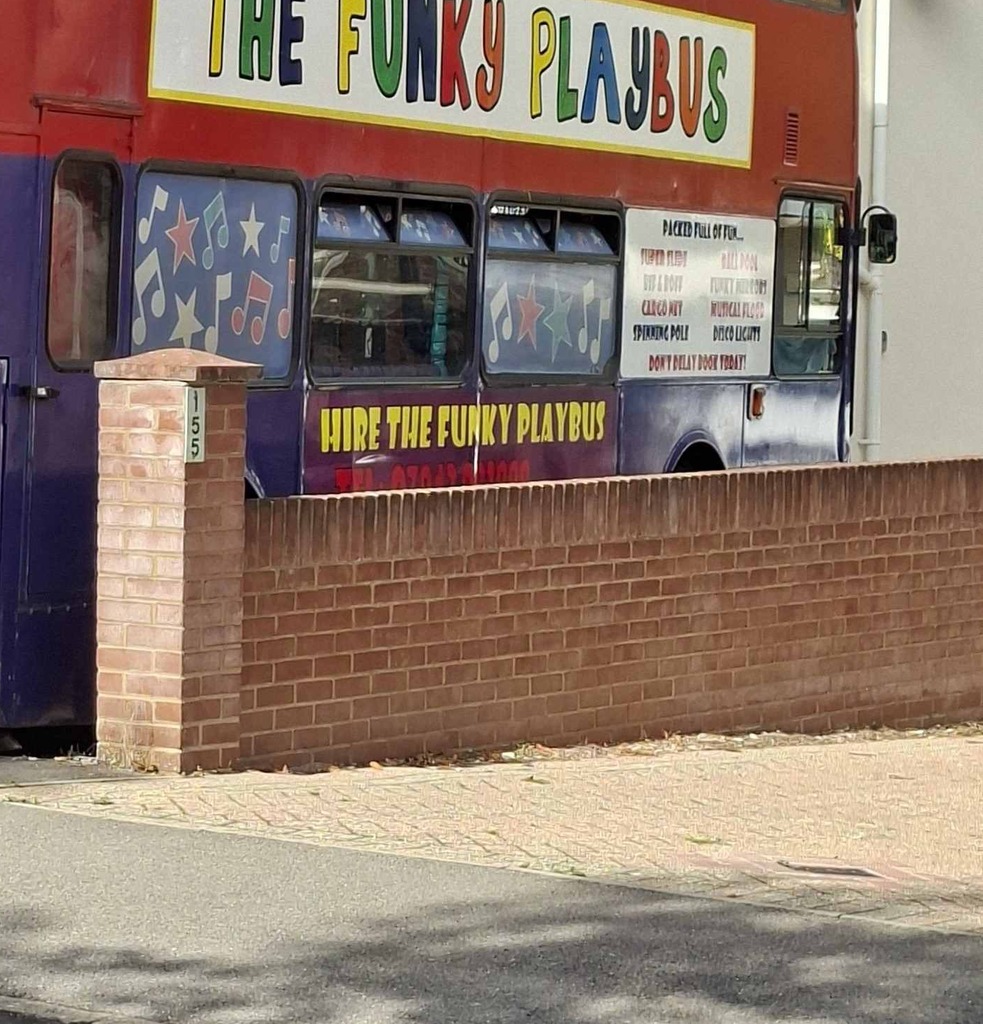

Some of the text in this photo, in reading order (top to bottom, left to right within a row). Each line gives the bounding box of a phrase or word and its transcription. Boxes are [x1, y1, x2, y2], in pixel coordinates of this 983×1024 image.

[529, 7, 728, 143] PLAYBUS
[662, 219, 693, 237] PACKED
[694, 221, 711, 239] FULL
[320, 400, 606, 452] HIRE THE FUNKY PLAYBUS
